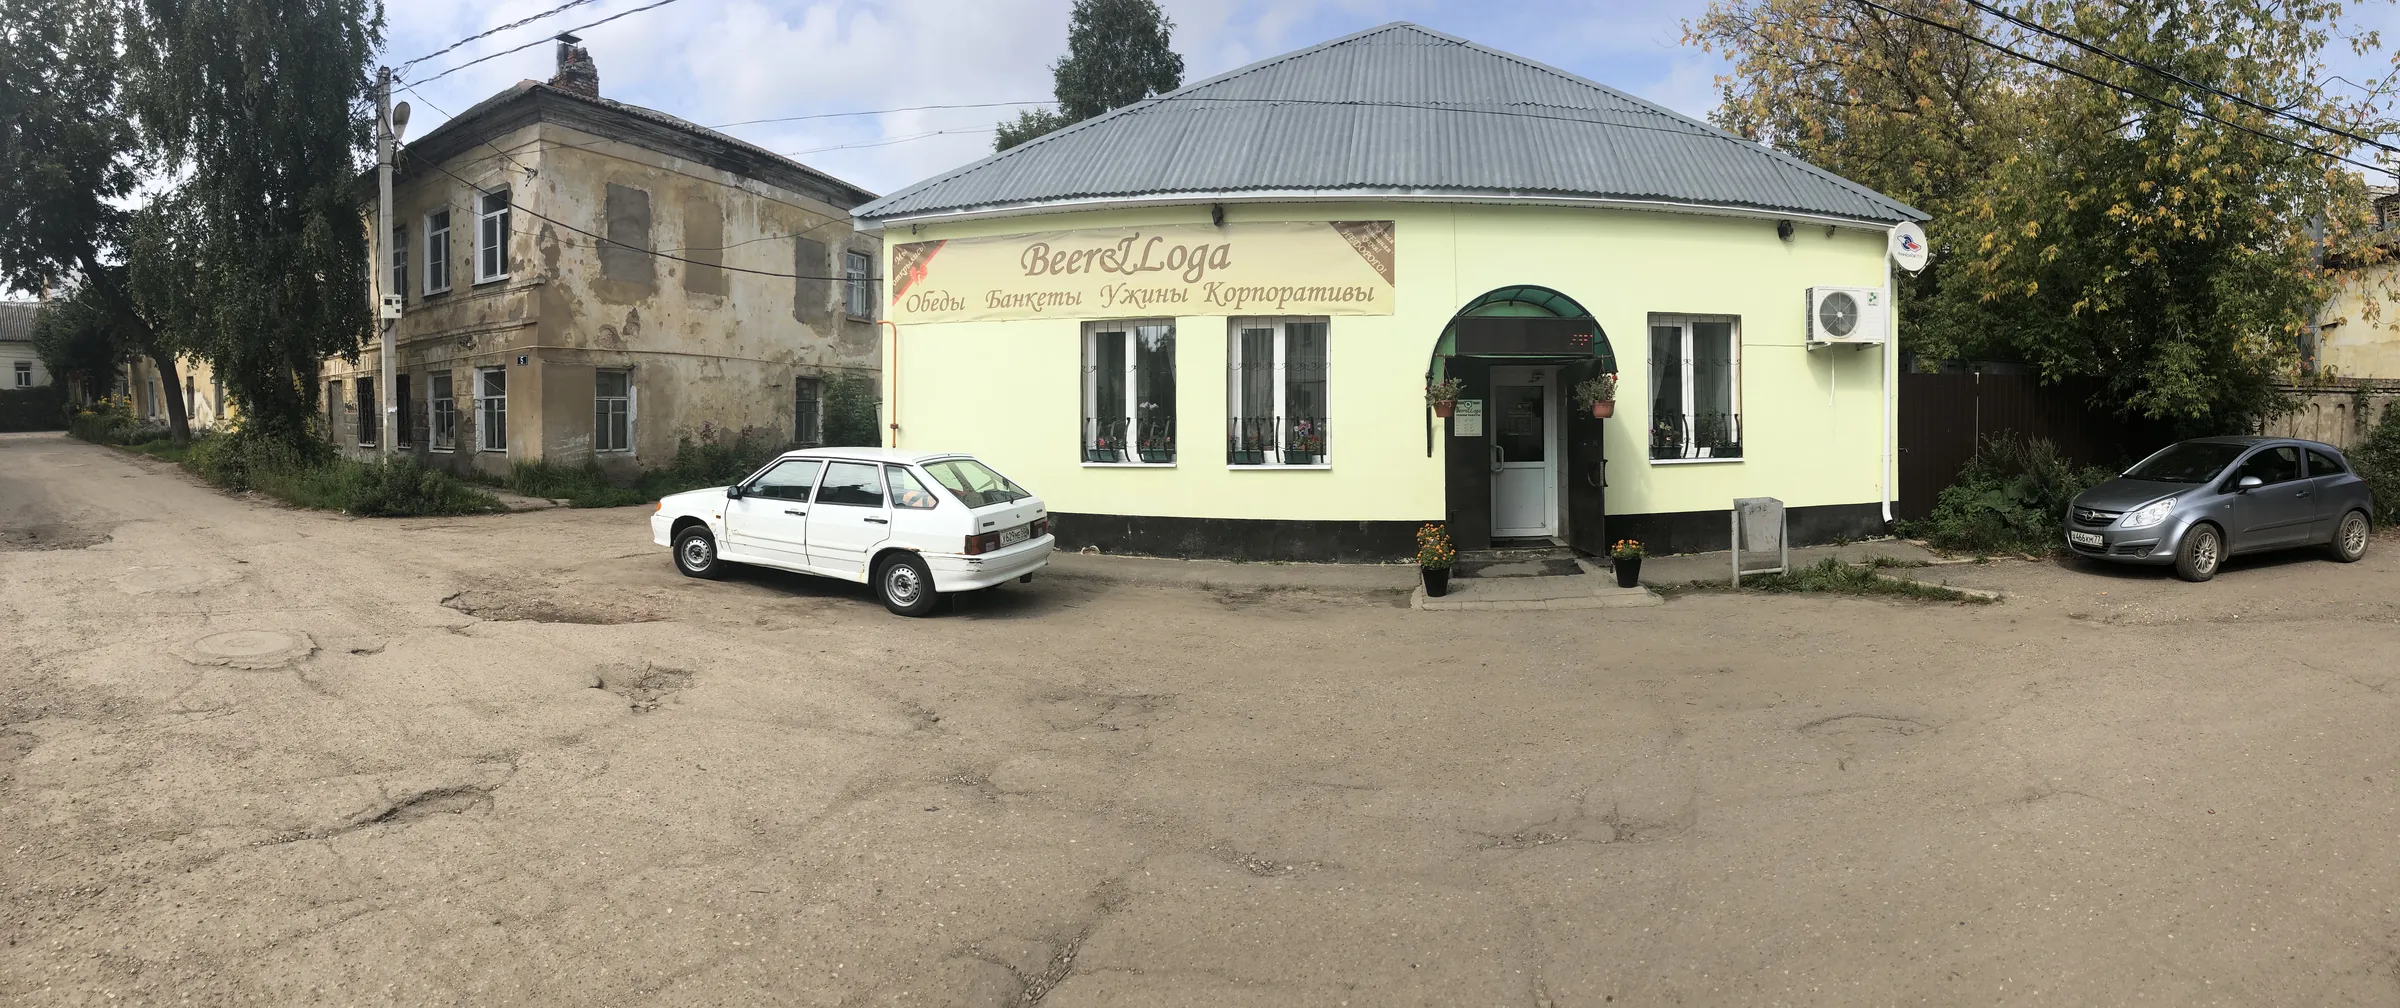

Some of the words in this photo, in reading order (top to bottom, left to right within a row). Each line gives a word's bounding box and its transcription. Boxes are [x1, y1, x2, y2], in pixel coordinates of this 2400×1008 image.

[892, 242, 926, 286] открылись!
[894, 249, 909, 265] Мы
[1341, 229, 1387, 274] НЕДОРОГО!
[906, 290, 965, 313] Обеды
[985, 289, 1082, 312] Банкеты
[1100, 282, 1189, 310] Ужины
[1203, 281, 1375, 310] Корпоративы
